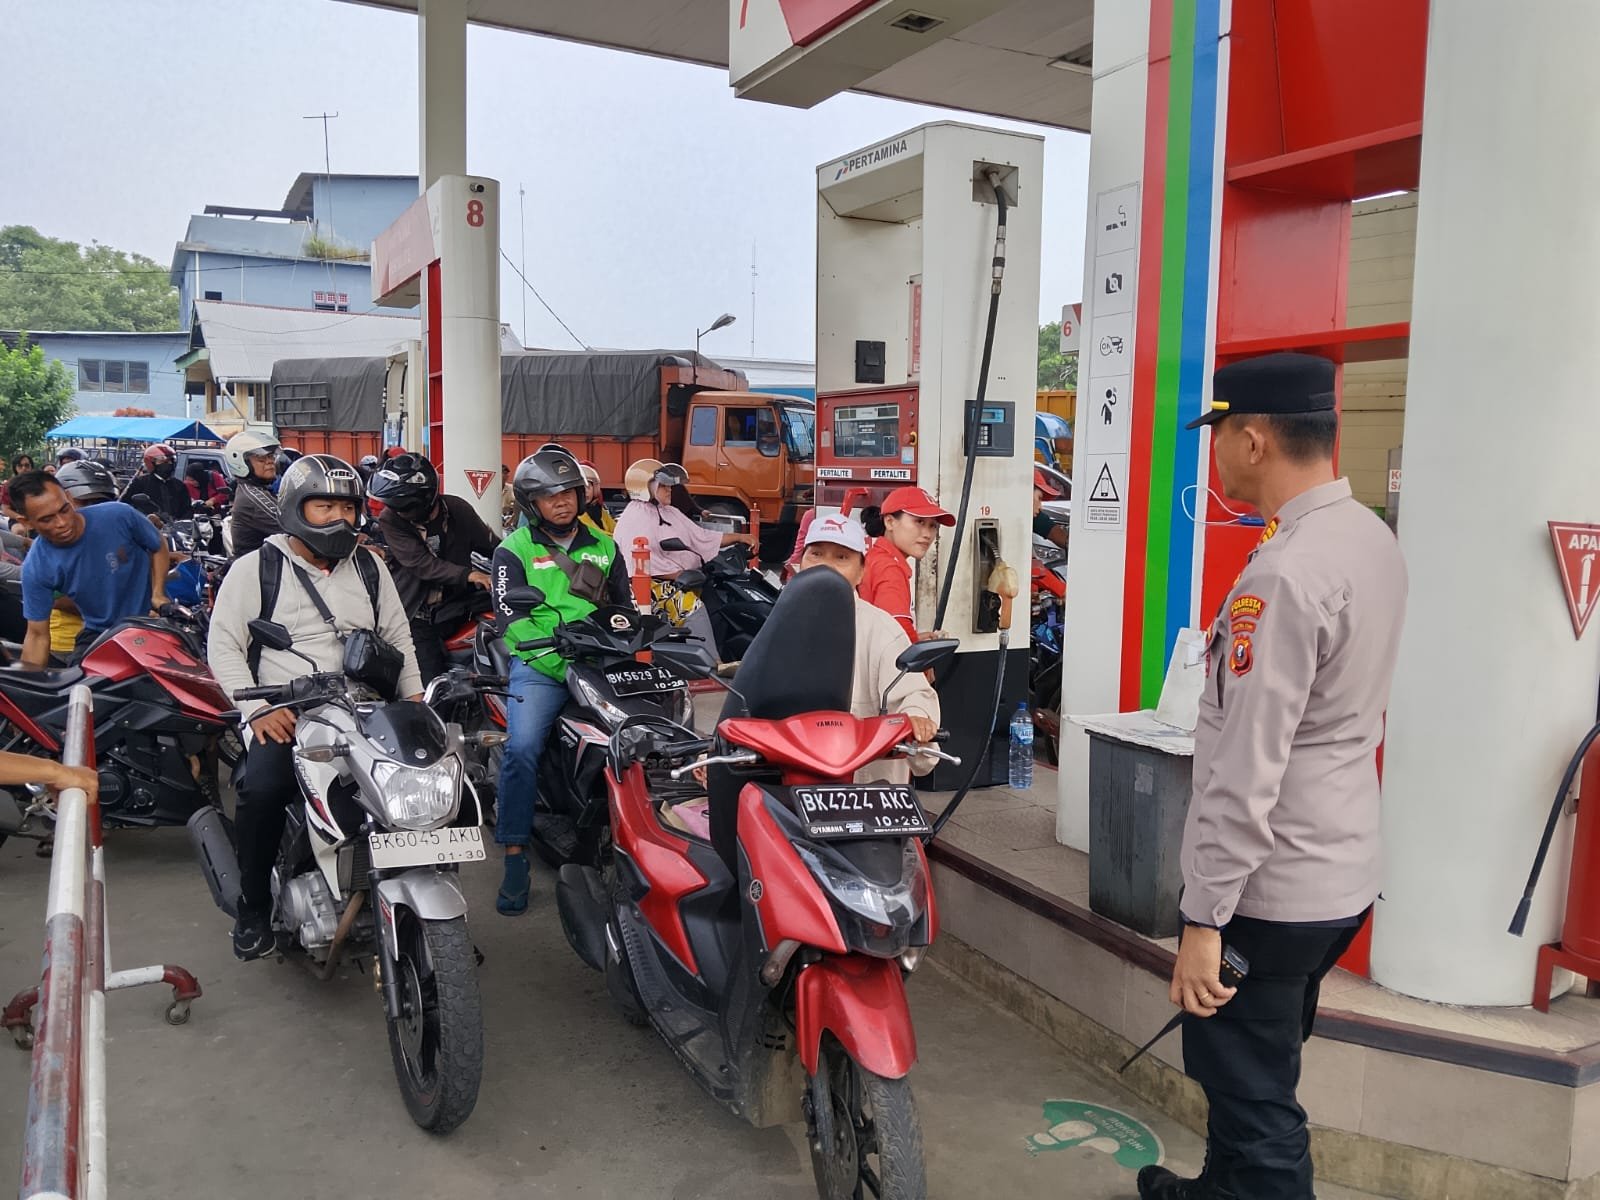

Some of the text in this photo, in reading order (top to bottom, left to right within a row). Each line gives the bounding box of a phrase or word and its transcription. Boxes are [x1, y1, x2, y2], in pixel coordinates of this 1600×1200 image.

[849, 139, 908, 172] PERTAMINA
[466, 199, 485, 228] 8
[1063, 320, 1072, 337] 6
[820, 469, 849, 478] PERTALITE
[873, 470, 907, 479] PERTALITE
[980, 505, 991, 516] 19
[1568, 534, 1600, 551] APA
[816, 720, 844, 728] YAMAHA
[879, 791, 914, 810] AKC
[449, 828, 481, 844] AKU
[817, 825, 844, 834] YAMAHA
